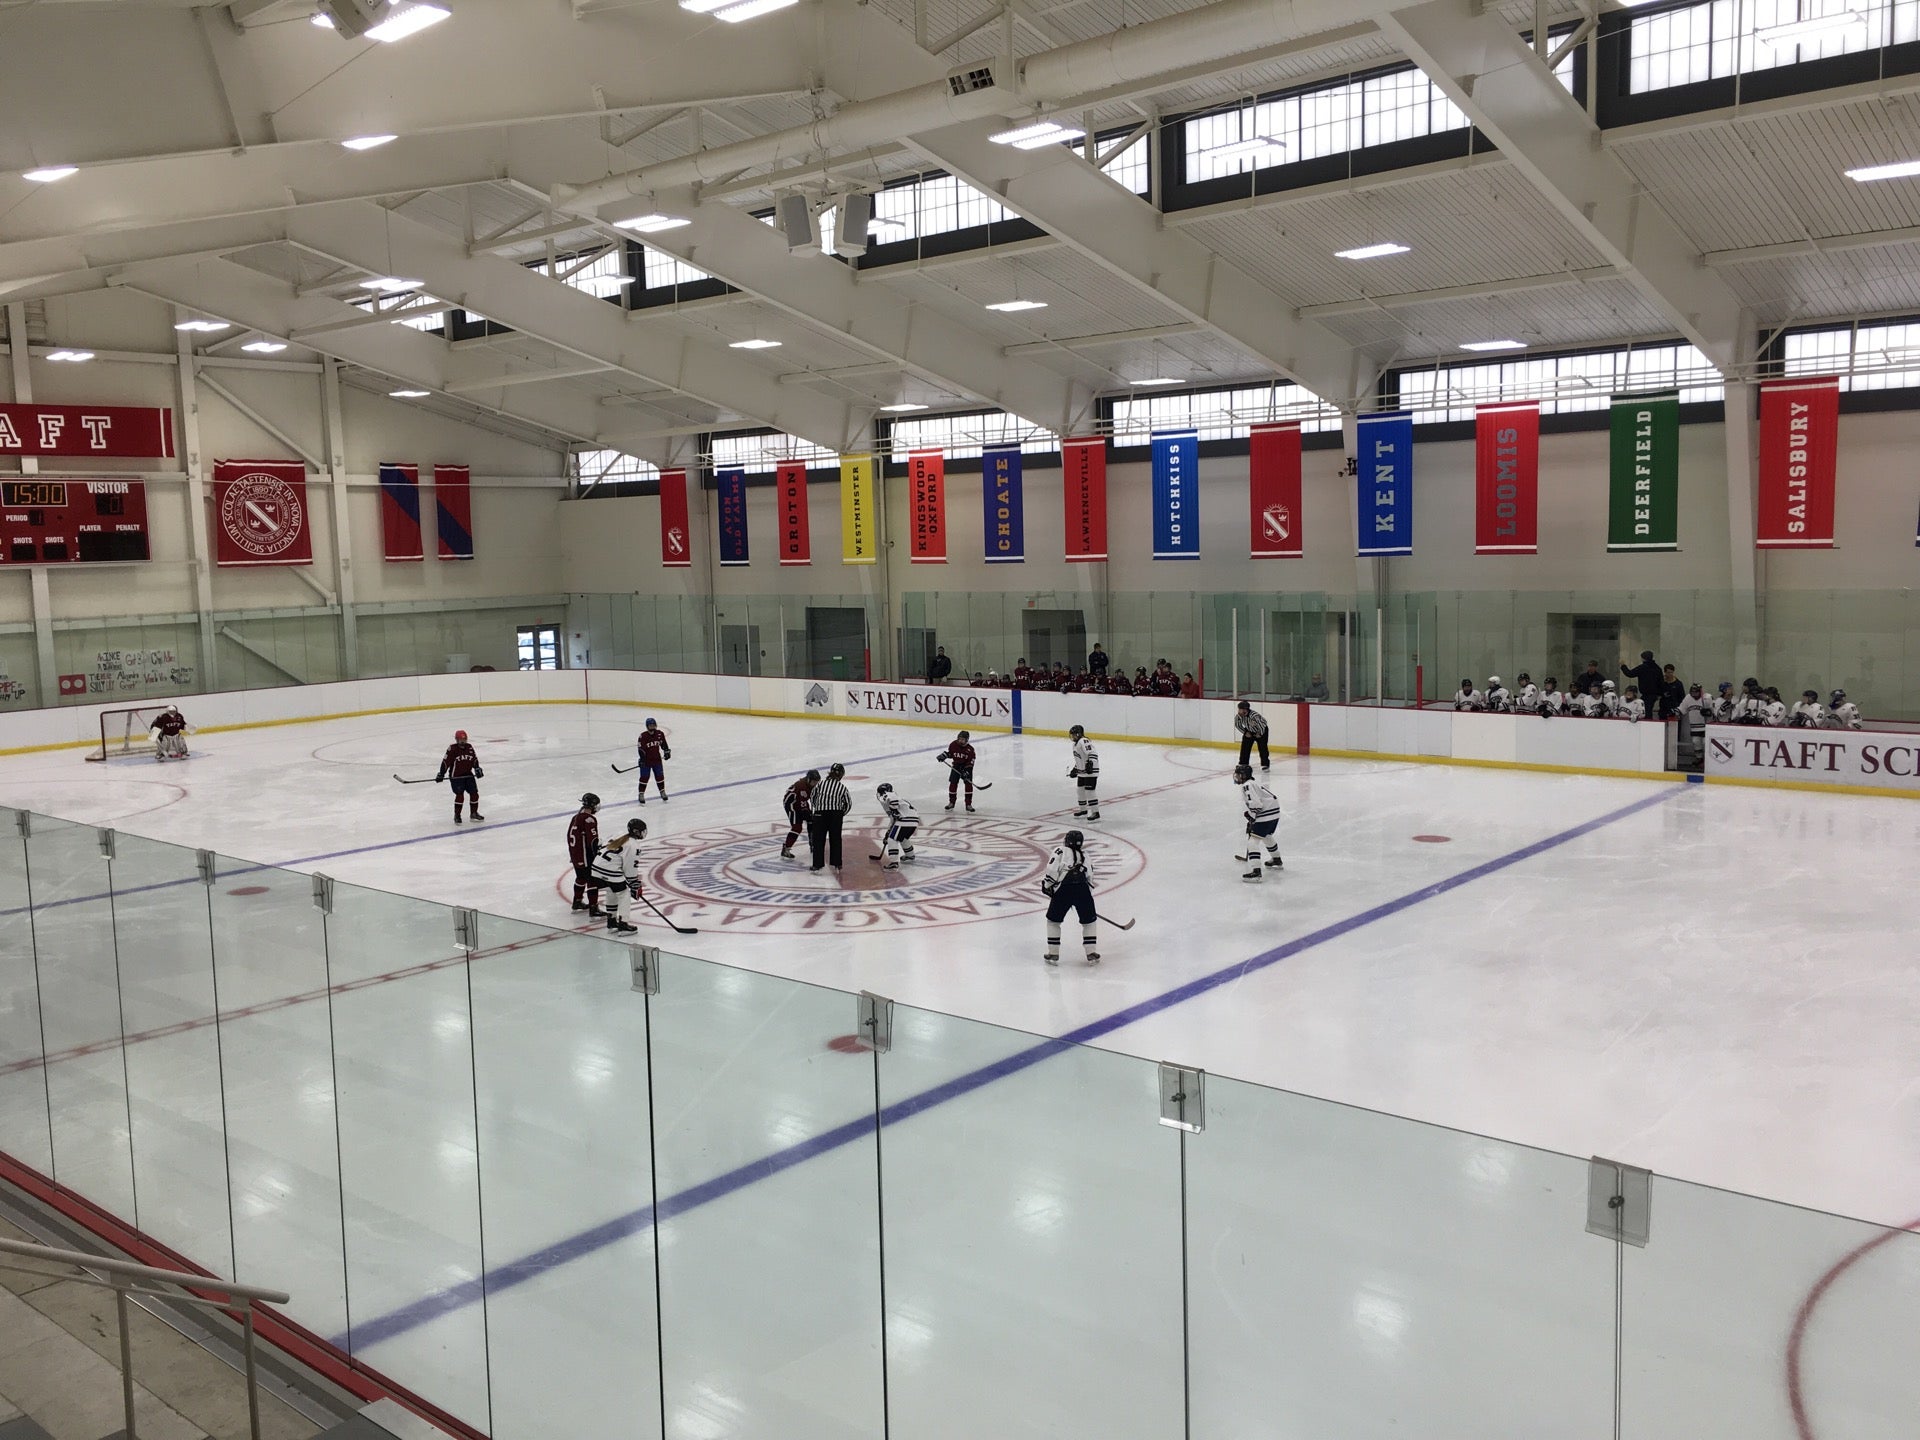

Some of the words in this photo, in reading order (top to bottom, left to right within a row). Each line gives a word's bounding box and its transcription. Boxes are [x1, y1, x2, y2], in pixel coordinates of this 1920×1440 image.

[14, 484, 63, 504] 15:00
[87, 482, 129, 493] VISITOR
[1170, 444, 1181, 545] HOTCHKISS
[1375, 440, 1394, 532] KENT
[1497, 428, 1518, 536] LOOMIS
[1635, 410, 1652, 535] DEERFIELD
[1788, 402, 1808, 533] SALISBURY
[5, 514, 28, 522] PERIOD
[724, 497, 733, 535] AVON
[731, 474, 741, 523] FARMS
[787, 472, 799, 553] GROTON
[852, 466, 862, 556] WESTMINSTER
[916, 460, 927, 551] KINGSWOOD
[928, 473, 938, 534] OXFORD
[996, 458, 1011, 551] CHOATE
[1080, 447, 1090, 552] LAWRENCEVILLE
[79, 524, 101, 532] PLAYER
[863, 690, 908, 712] TAFT
[914, 693, 993, 718] SCHOOL
[1744, 738, 1847, 772] TAFT
[1860, 744, 1920, 777] SC
[569, 825, 578, 847] 5
[591, 828, 597, 836] 5
[721, 899, 981, 929] ANGLIA
